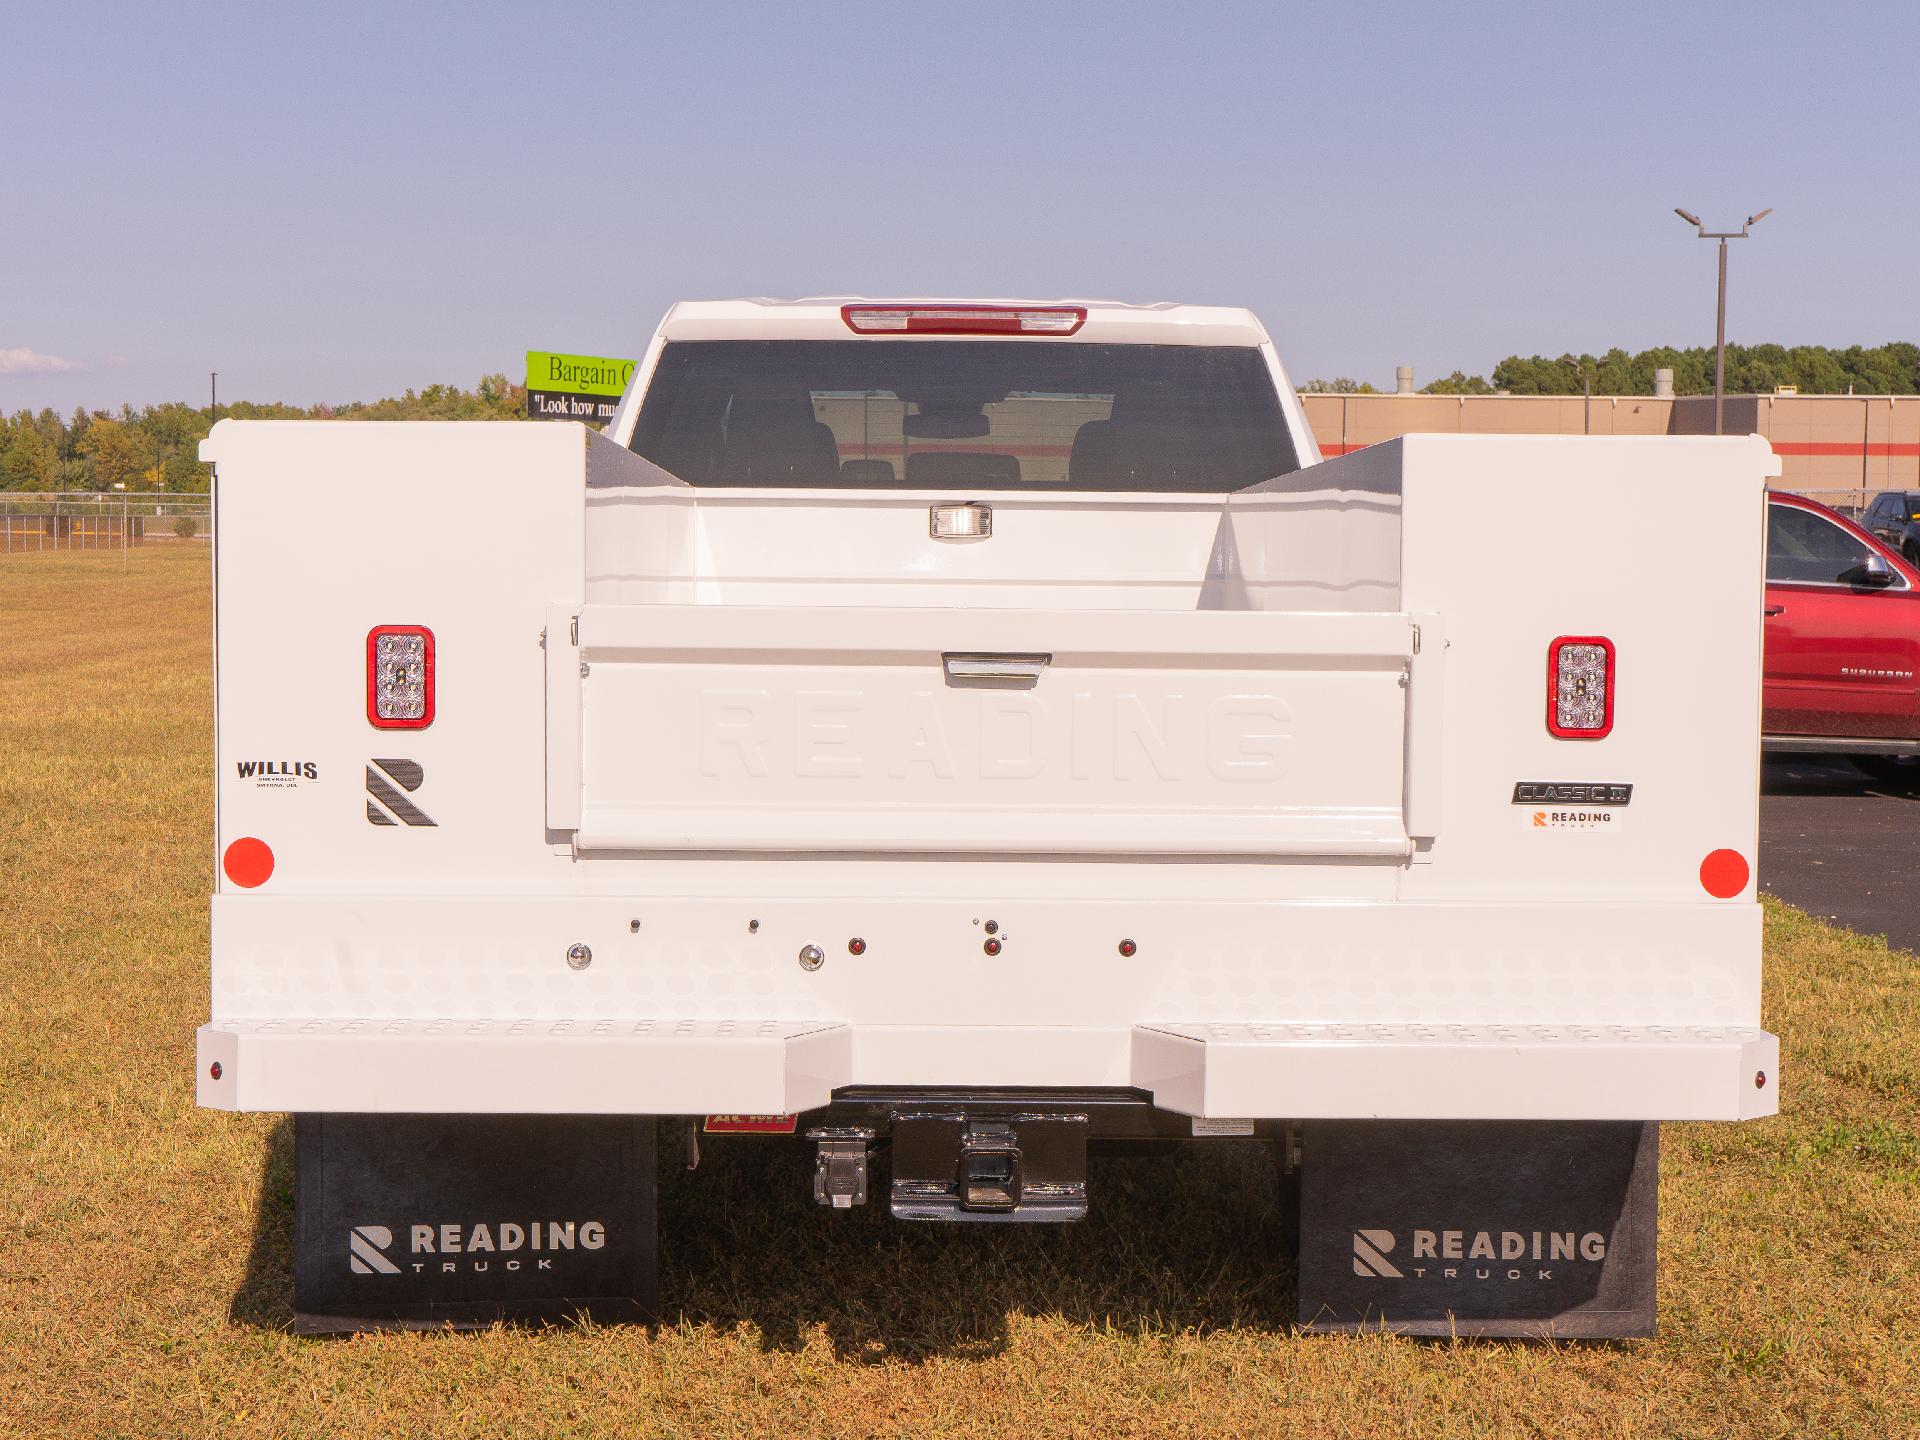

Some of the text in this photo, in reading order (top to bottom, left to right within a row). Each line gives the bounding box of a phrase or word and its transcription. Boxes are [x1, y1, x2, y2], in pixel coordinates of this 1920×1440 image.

[548, 356, 635, 390] Bargain O
[534, 394, 618, 417] "Look how mu
[1841, 667, 1913, 678] SUBURBAN
[700, 689, 1294, 782] READING
[236, 761, 319, 780] WILLIS
[1518, 785, 1605, 800] CLASSIC
[1551, 812, 1611, 822] READING
[411, 1221, 605, 1253] READING
[1413, 1230, 1605, 1261] READING
[411, 1259, 552, 1273] TRUCK
[1413, 1268, 1552, 1280] TRUCK
